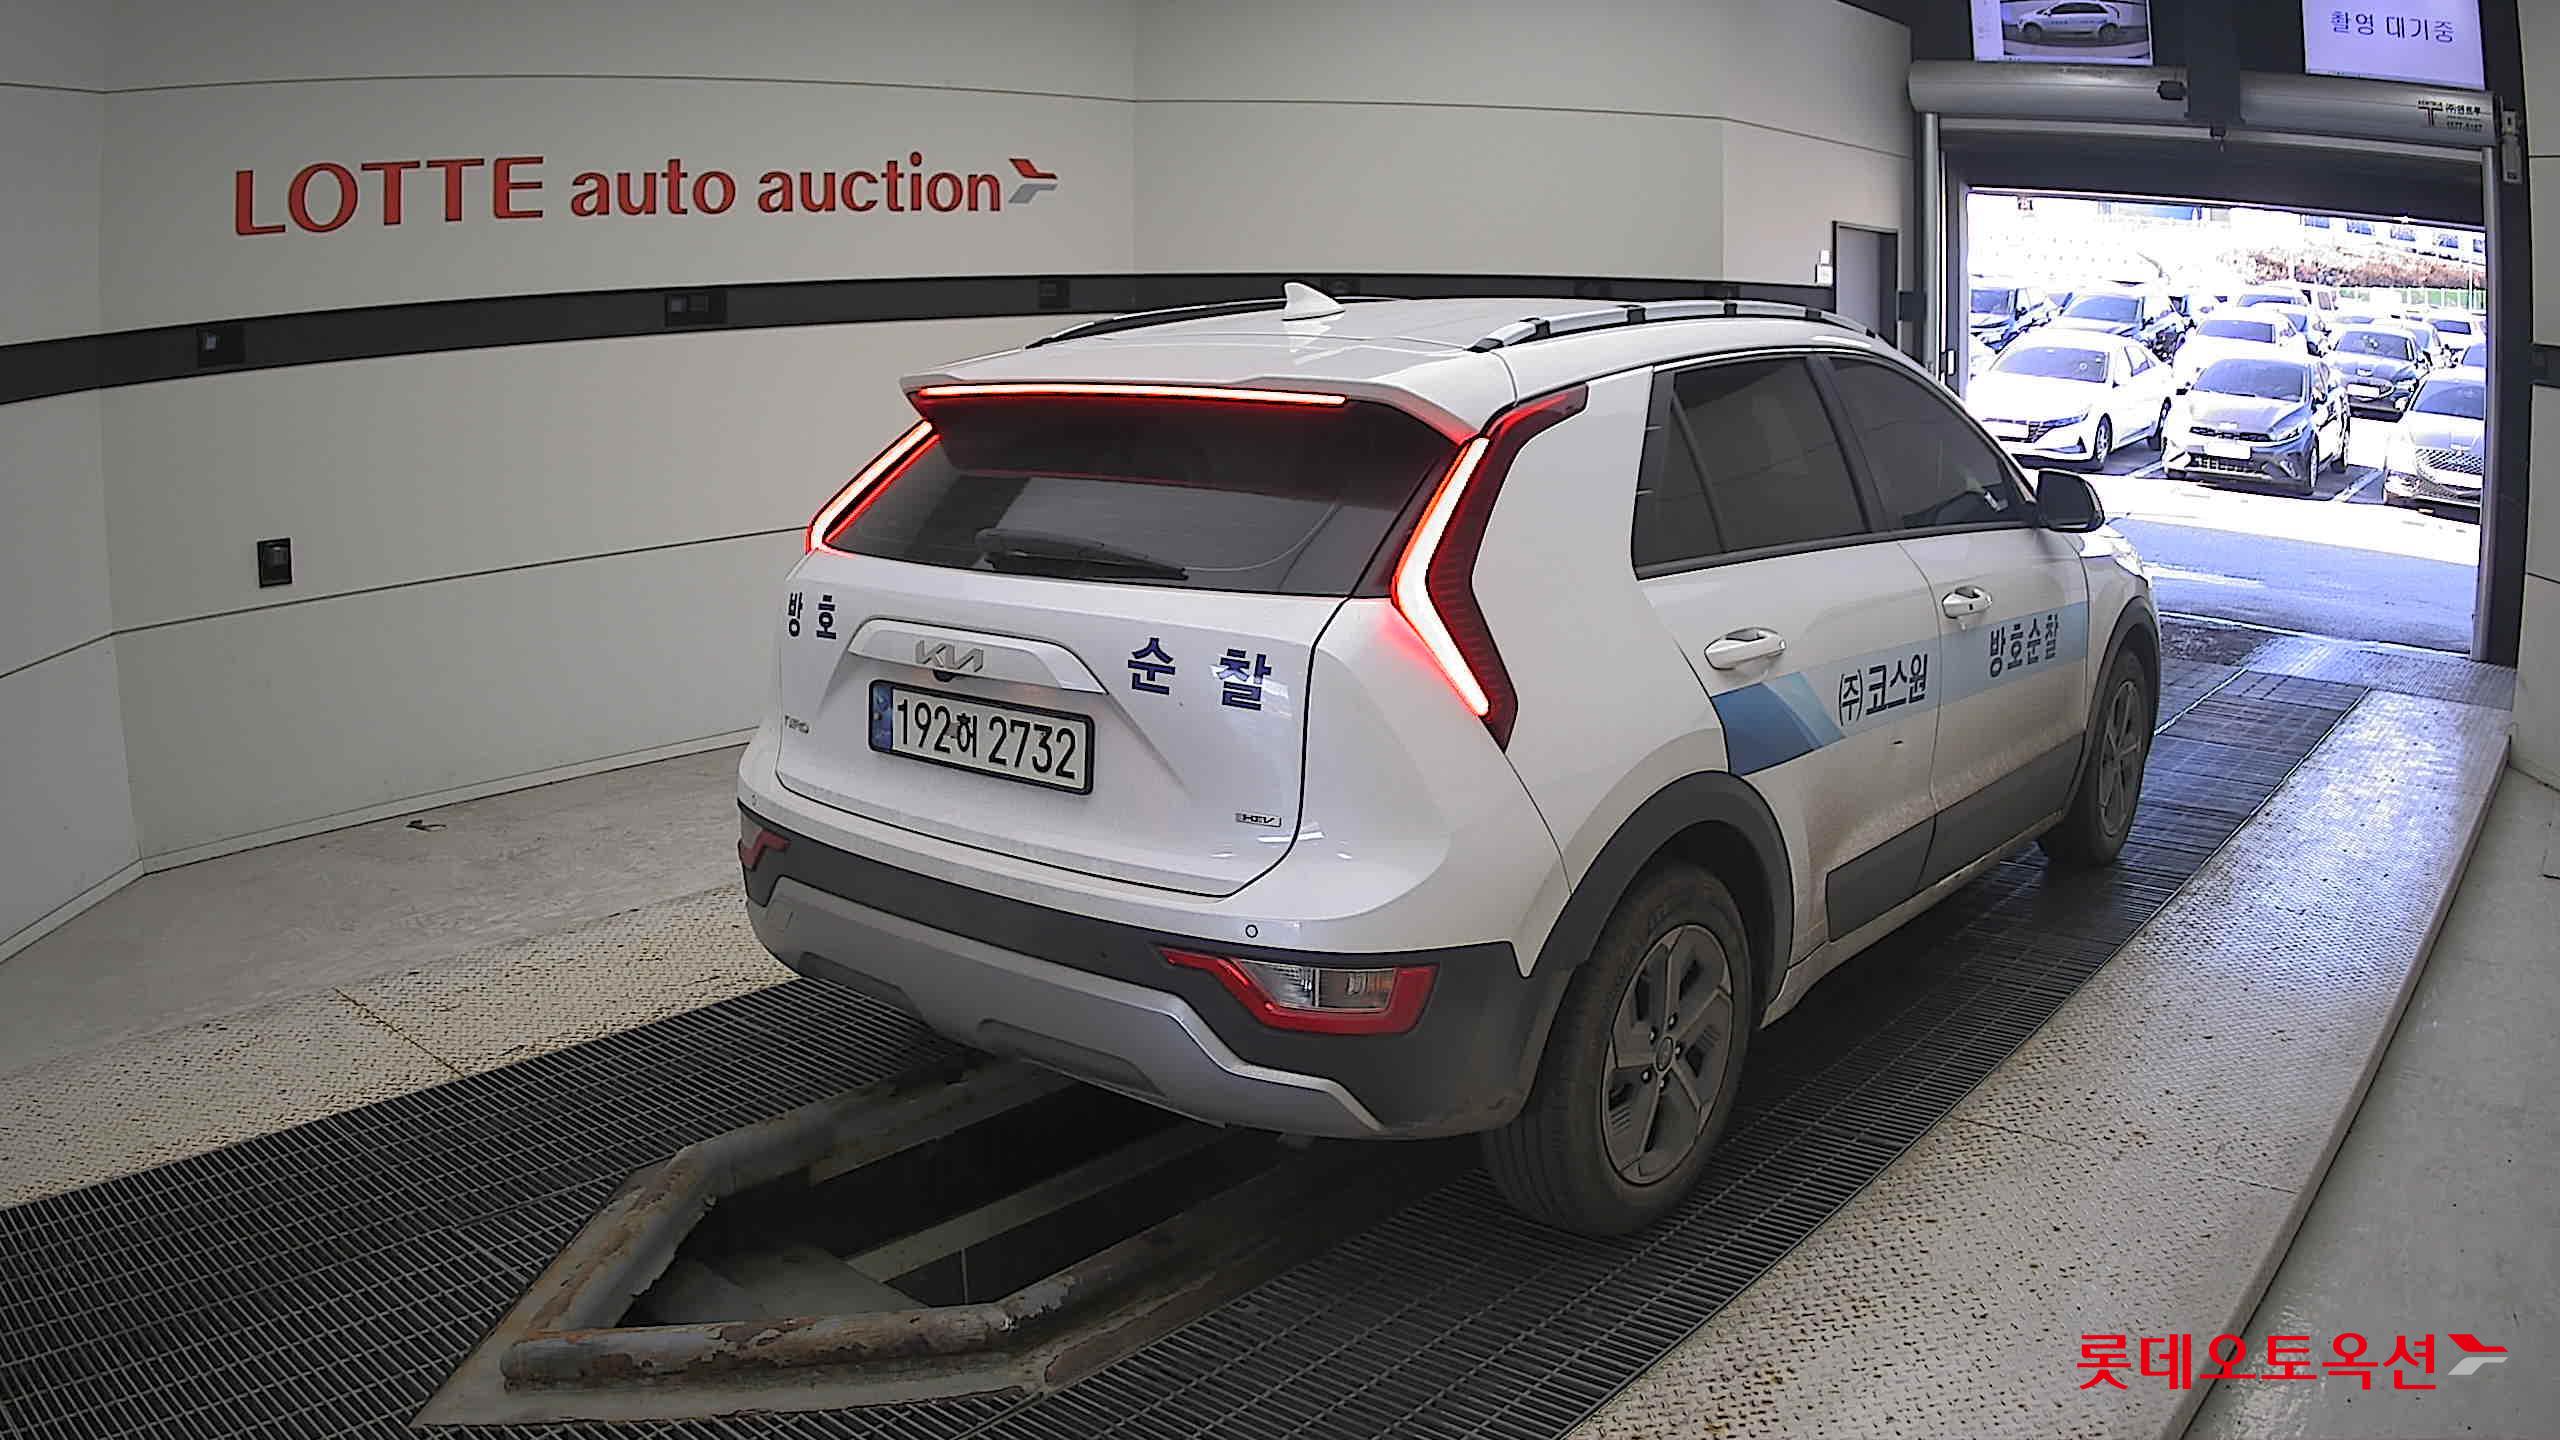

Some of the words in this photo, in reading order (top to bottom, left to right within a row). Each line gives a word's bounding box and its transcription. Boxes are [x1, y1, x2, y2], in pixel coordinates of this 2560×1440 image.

[2331, 11, 2374, 35] 촬영
[2386, 16, 2454, 43] 대기중
[235, 156, 544, 236] LOTTE
[571, 158, 736, 218] auto
[758, 151, 1001, 216] auction
[1990, 613, 2058, 678] 방호순찰
[1839, 653, 1928, 726] (주)코스원
